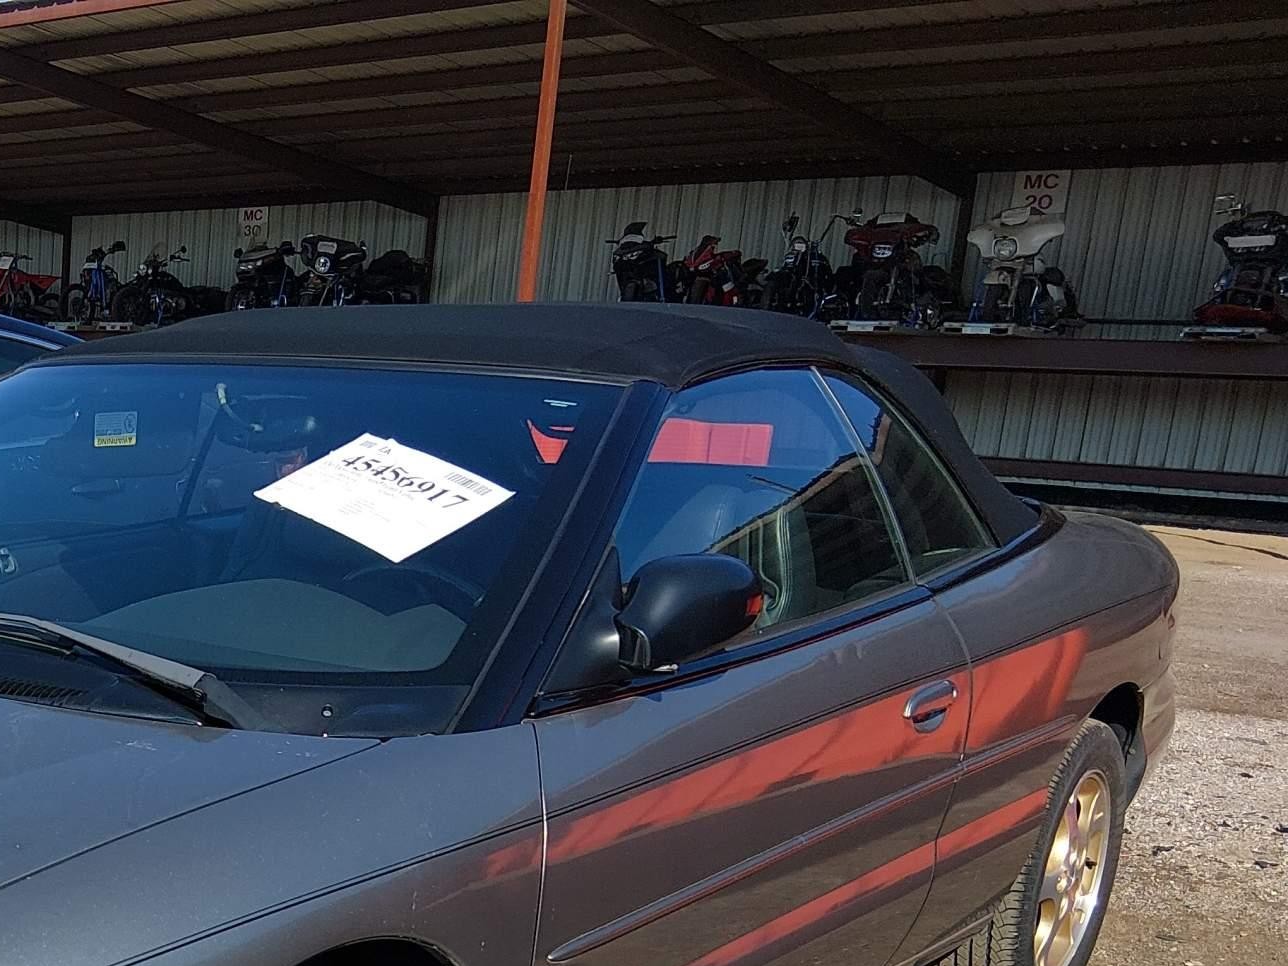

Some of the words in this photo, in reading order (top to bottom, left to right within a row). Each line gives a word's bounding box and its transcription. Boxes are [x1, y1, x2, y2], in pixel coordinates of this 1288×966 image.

[1024, 173, 1060, 190] MC
[1025, 194, 1053, 210] 20
[243, 209, 263, 221] MC
[244, 224, 262, 237] 30
[342, 455, 470, 508] 45456917
